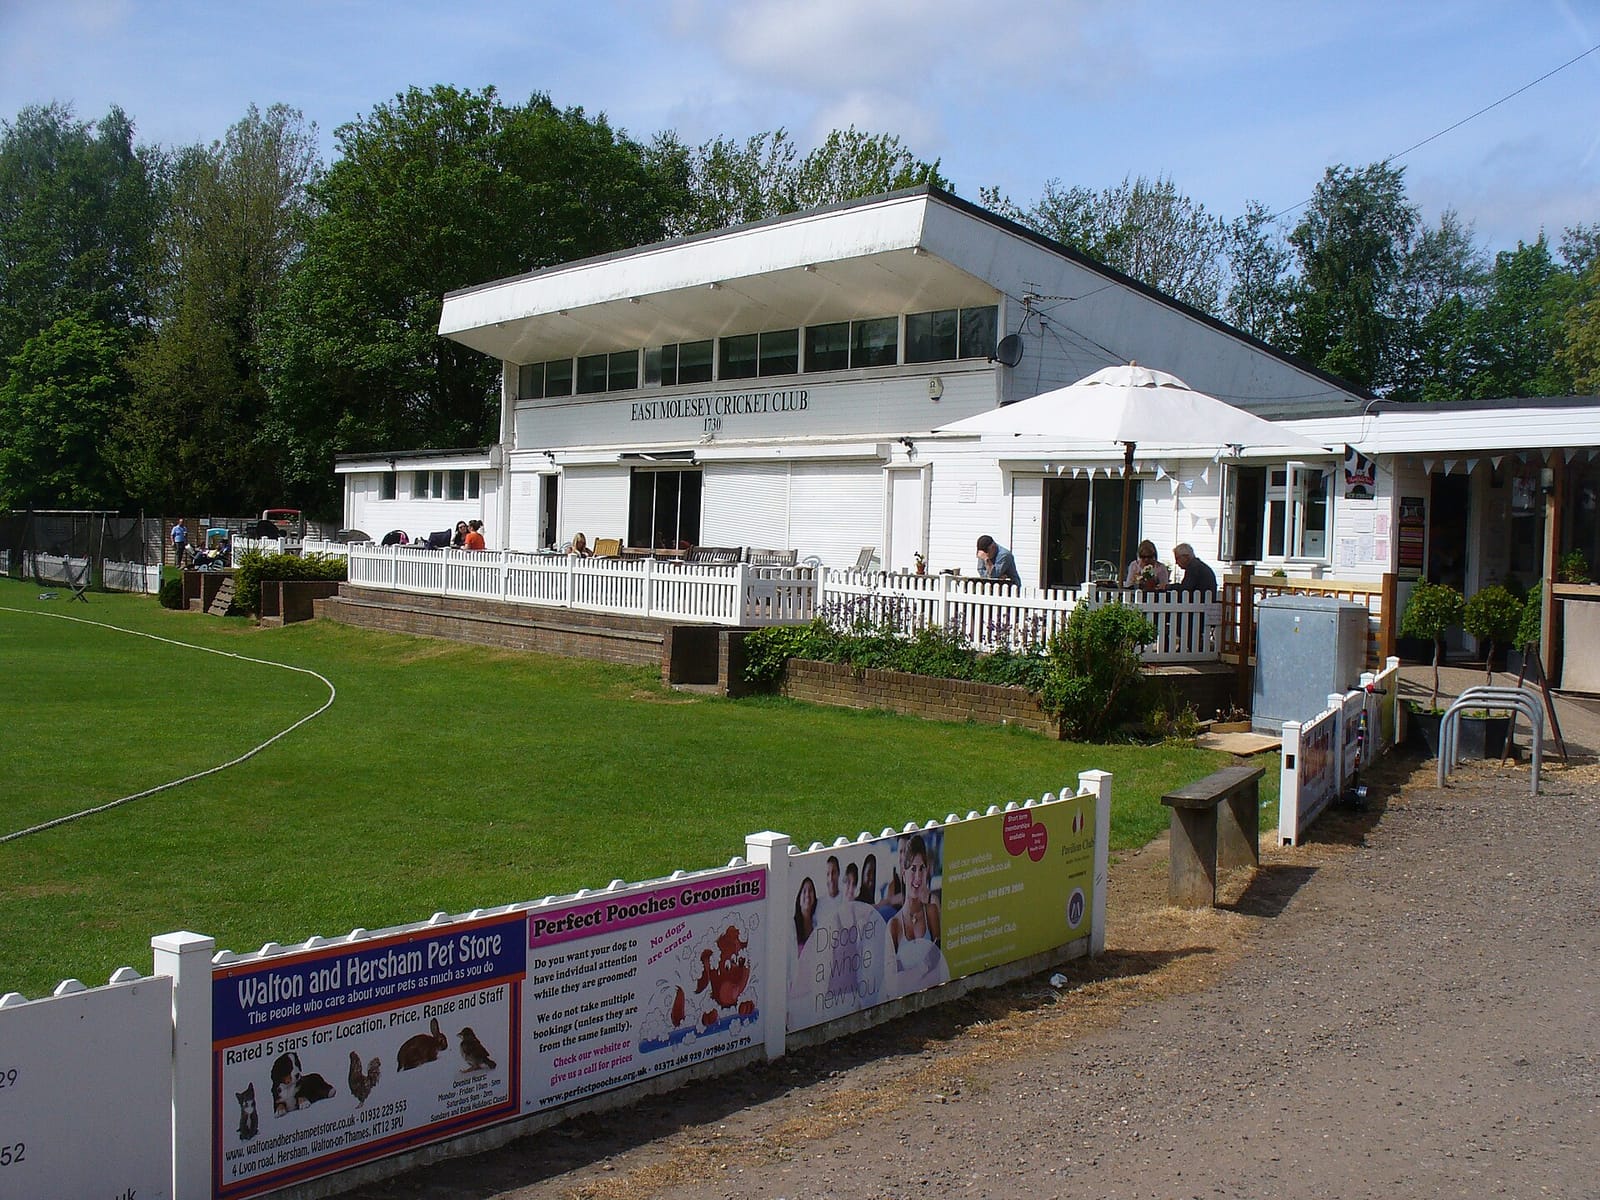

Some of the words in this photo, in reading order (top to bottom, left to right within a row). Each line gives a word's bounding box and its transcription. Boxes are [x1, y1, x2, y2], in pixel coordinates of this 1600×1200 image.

[631, 402, 658, 421] EAST
[660, 398, 713, 419] MOLESEY
[714, 393, 771, 416] CRICKET
[772, 391, 808, 411] CLUB
[704, 418, 721, 431] 1730
[533, 908, 602, 938] Perfect
[606, 894, 676, 922] Pooches
[680, 879, 760, 906] Grooming
[647, 949, 663, 965] are
[664, 930, 693, 954] crated
[650, 935, 664, 949] No
[665, 921, 686, 940] dogs
[816, 919, 878, 953] Discover
[533, 974, 555, 985] have
[599, 954, 638, 970] attention
[534, 959, 547, 970] Do
[548, 956, 565, 968] you
[566, 950, 589, 962] want
[590, 945, 611, 959] your
[612, 941, 627, 952] dog
[628, 939, 638, 948] to
[815, 963, 825, 983] a
[829, 949, 872, 978] whole
[238, 973, 303, 1009] Walton
[309, 960, 340, 994] and
[347, 950, 422, 986] Hersham
[428, 940, 454, 969] Pet
[460, 934, 502, 962] Store
[533, 986, 560, 1001] while
[561, 983, 581, 994] they
[581, 979, 596, 989] are
[597, 967, 638, 988] groomed?
[248, 1011, 267, 1025] The
[270, 1002, 301, 1020] people
[303, 999, 322, 1013] who
[325, 994, 345, 1008] care
[347, 988, 373, 1003] about
[375, 985, 394, 998] your
[397, 979, 415, 992] pets
[418, 976, 428, 987] as
[430, 970, 453, 985] much
[455, 967, 465, 979] as
[466, 964, 482, 978] you
[483, 961, 493, 973] do
[536, 1013, 550, 1024] We
[551, 1010, 563, 1020] do
[564, 1006, 579, 1017] not
[580, 1001, 599, 1013] take
[600, 992, 635, 1008] multiple
[815, 985, 848, 1013] new
[226, 1043, 262, 1066] Rated
[266, 1042, 273, 1056] 5
[277, 1034, 308, 1051] stars
[311, 1029, 333, 1045] for:
[423, 1000, 455, 1019] Range
[458, 993, 476, 1010] and
[478, 986, 504, 1005] Staff
[533, 1023, 573, 1040] bookings
[574, 1015, 604, 1031] (unless
[605, 1009, 624, 1021] they
[625, 1005, 638, 1014] are
[539, 1041, 560, 1053] from
[562, 1036, 576, 1047] the
[578, 1030, 599, 1041] same
[553, 1054, 577, 1068] Check
[578, 1051, 592, 1061] our
[593, 1042, 621, 1056] website
[622, 1040, 631, 1049] or
[539, 1066, 647, 1106] www.perfectpooches.org.uk
[550, 1073, 567, 1087] give
[568, 1070, 577, 1079] us
[583, 1063, 597, 1075] call
[598, 1060, 609, 1070] for
[610, 1054, 633, 1069] prices
[360, 1107, 380, 1123] 01932
[381, 1103, 394, 1117] 229
[0, 1142, 26, 1166] 52
[232, 1164, 237, 1176] 4
[239, 1160, 257, 1175] Lyon
[372, 1120, 389, 1136] KT12
[391, 1115, 404, 1130] 3PU
